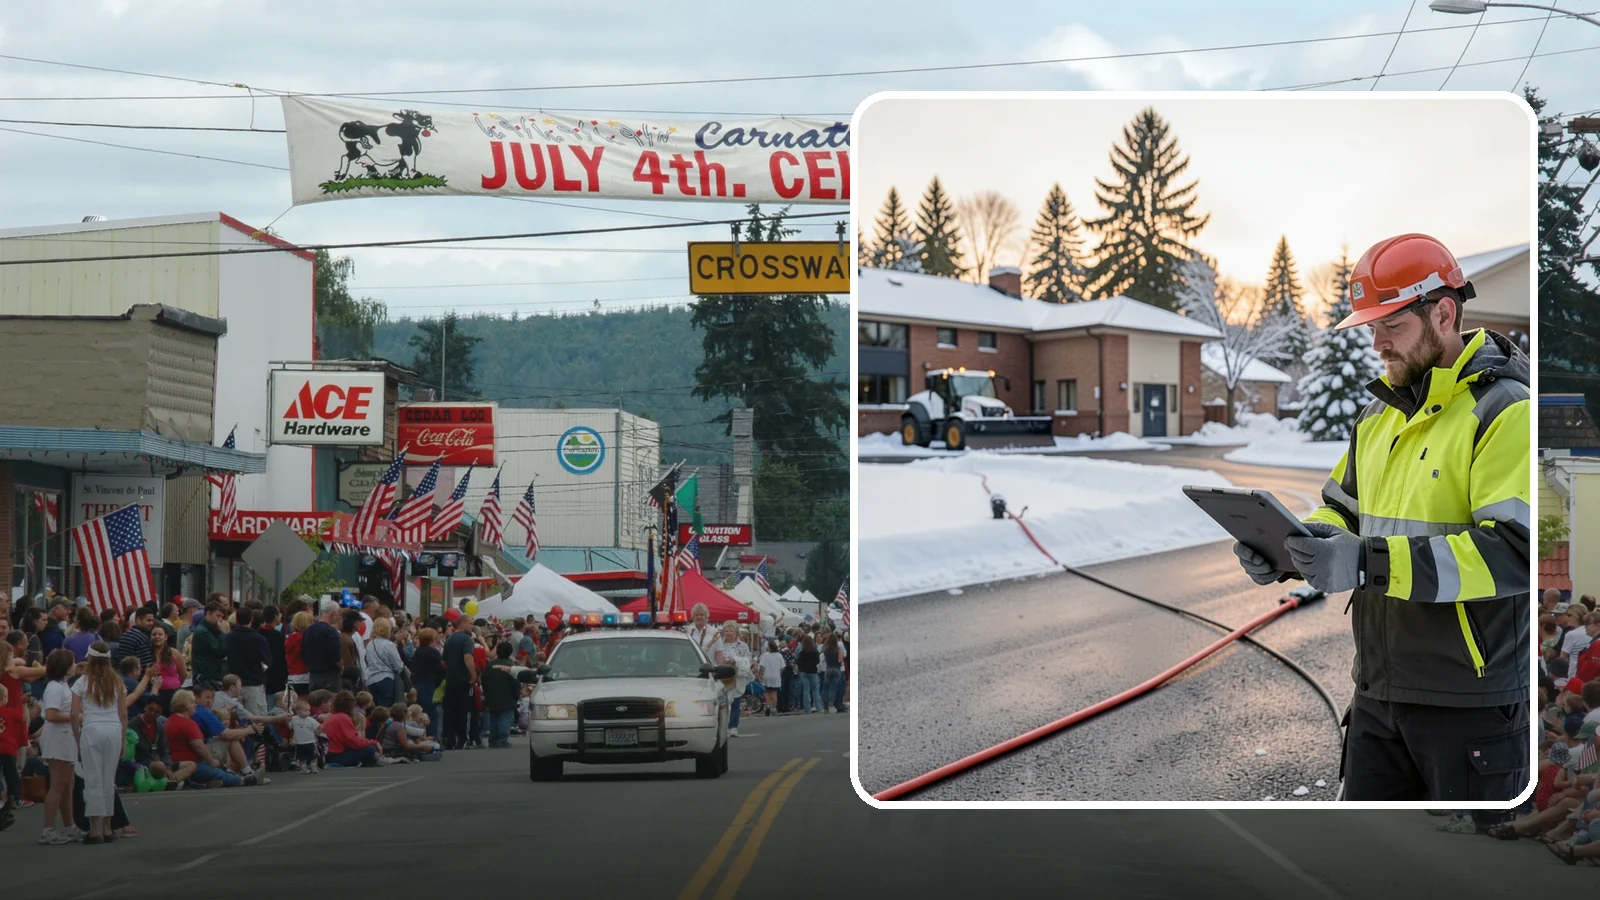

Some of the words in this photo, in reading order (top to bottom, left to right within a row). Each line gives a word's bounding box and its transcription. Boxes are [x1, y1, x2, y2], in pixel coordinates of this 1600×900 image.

[481, 141, 605, 193] JULY
[632, 150, 747, 198] 4th.
[697, 254, 850, 280] CROSSWA
[282, 380, 373, 420] ACE
[406, 409, 452, 422] CEDAR
[461, 409, 485, 422] LOG
[283, 421, 371, 437] Hardware
[416, 428, 477, 447] Coca-Cola
[353, 466, 386, 480] Simpl
[83, 484, 93, 494] St.
[95, 485, 124, 495] Vincent
[126, 486, 136, 495] de
[138, 486, 155, 495] Paul
[688, 526, 741, 535] CRNATION
[699, 535, 730, 543] GLASS
